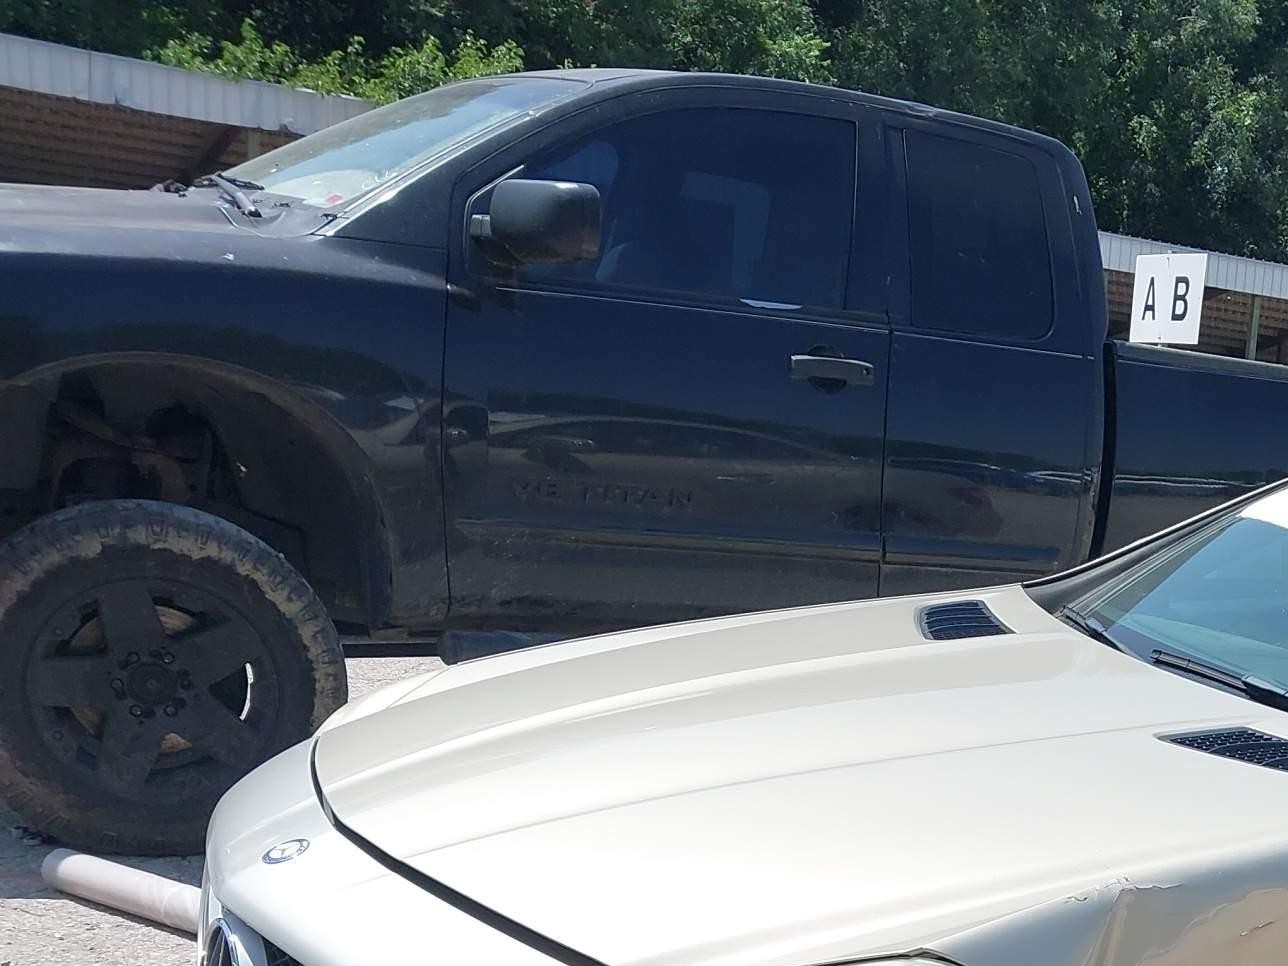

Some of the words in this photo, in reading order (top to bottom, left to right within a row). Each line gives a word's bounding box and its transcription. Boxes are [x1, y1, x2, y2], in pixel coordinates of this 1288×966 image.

[1142, 276, 1155, 320] A
[1171, 276, 1189, 320] B
[578, 482, 695, 510] TITAN
